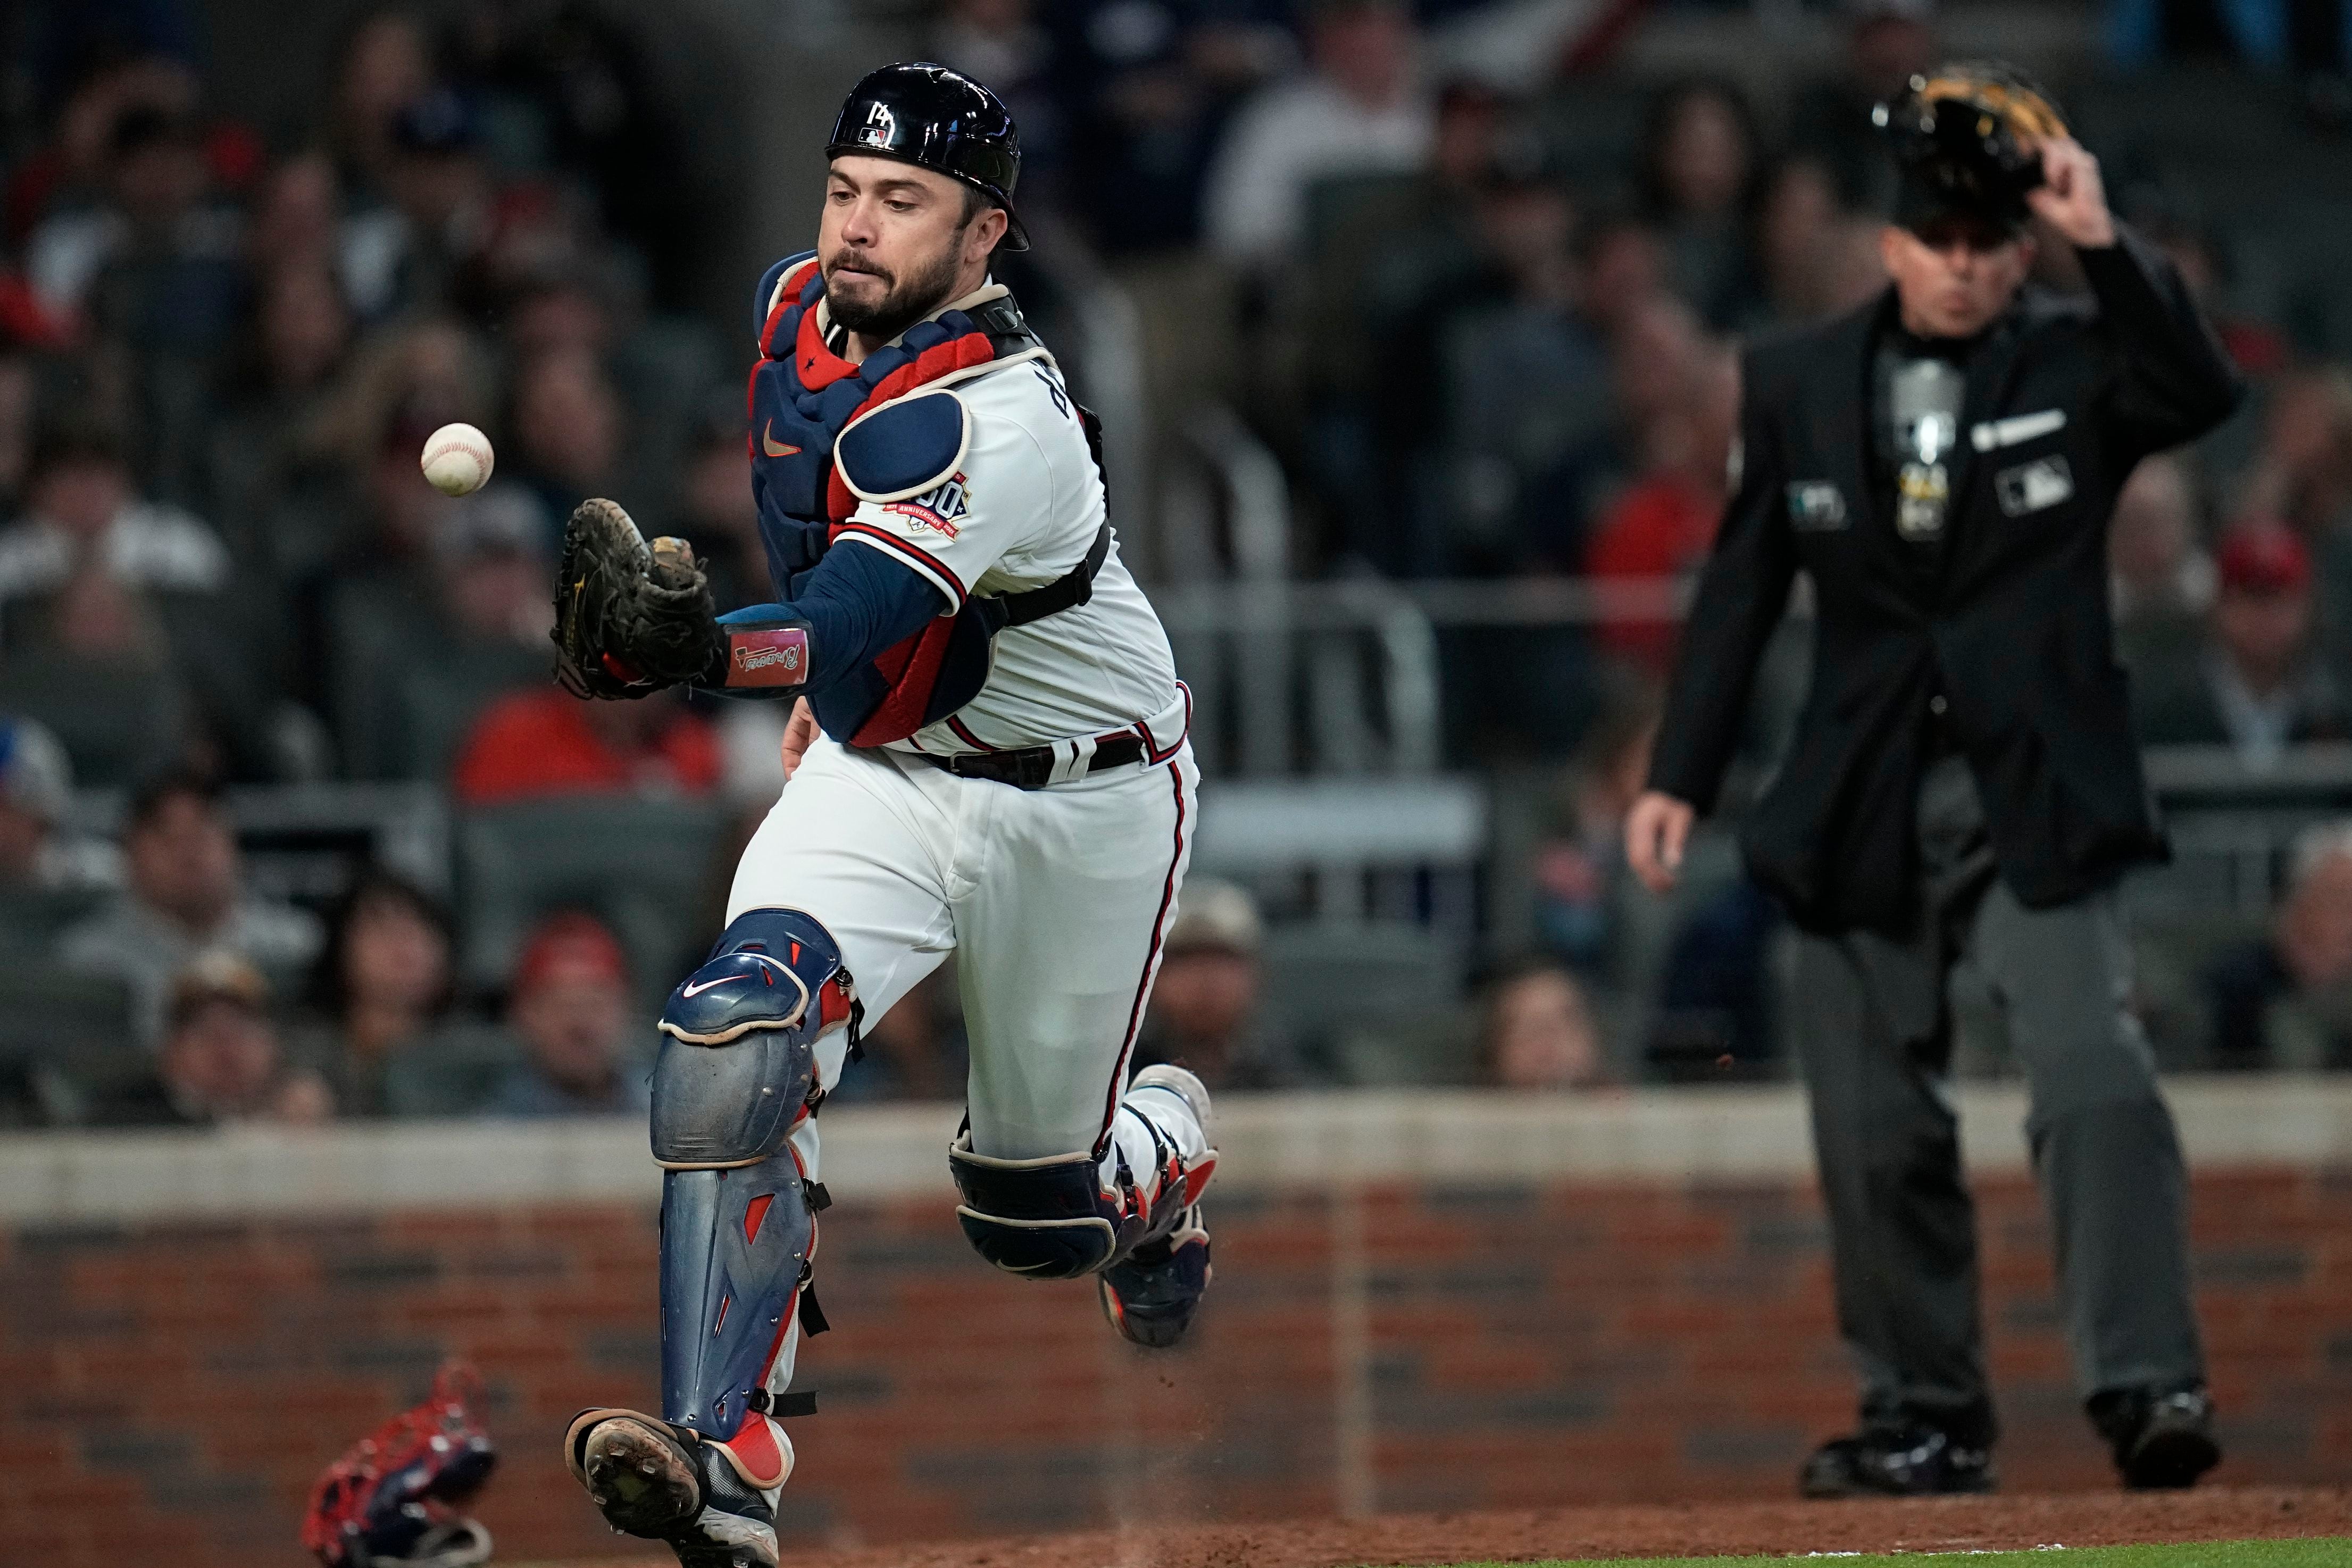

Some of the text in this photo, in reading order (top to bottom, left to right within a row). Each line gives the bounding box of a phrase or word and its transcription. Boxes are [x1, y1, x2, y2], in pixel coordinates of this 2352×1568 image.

[866, 102, 889, 127] 14
[899, 505, 941, 527] ANNIVERSARY
[944, 524, 955, 534] 2021
[745, 644, 800, 672] Braves
